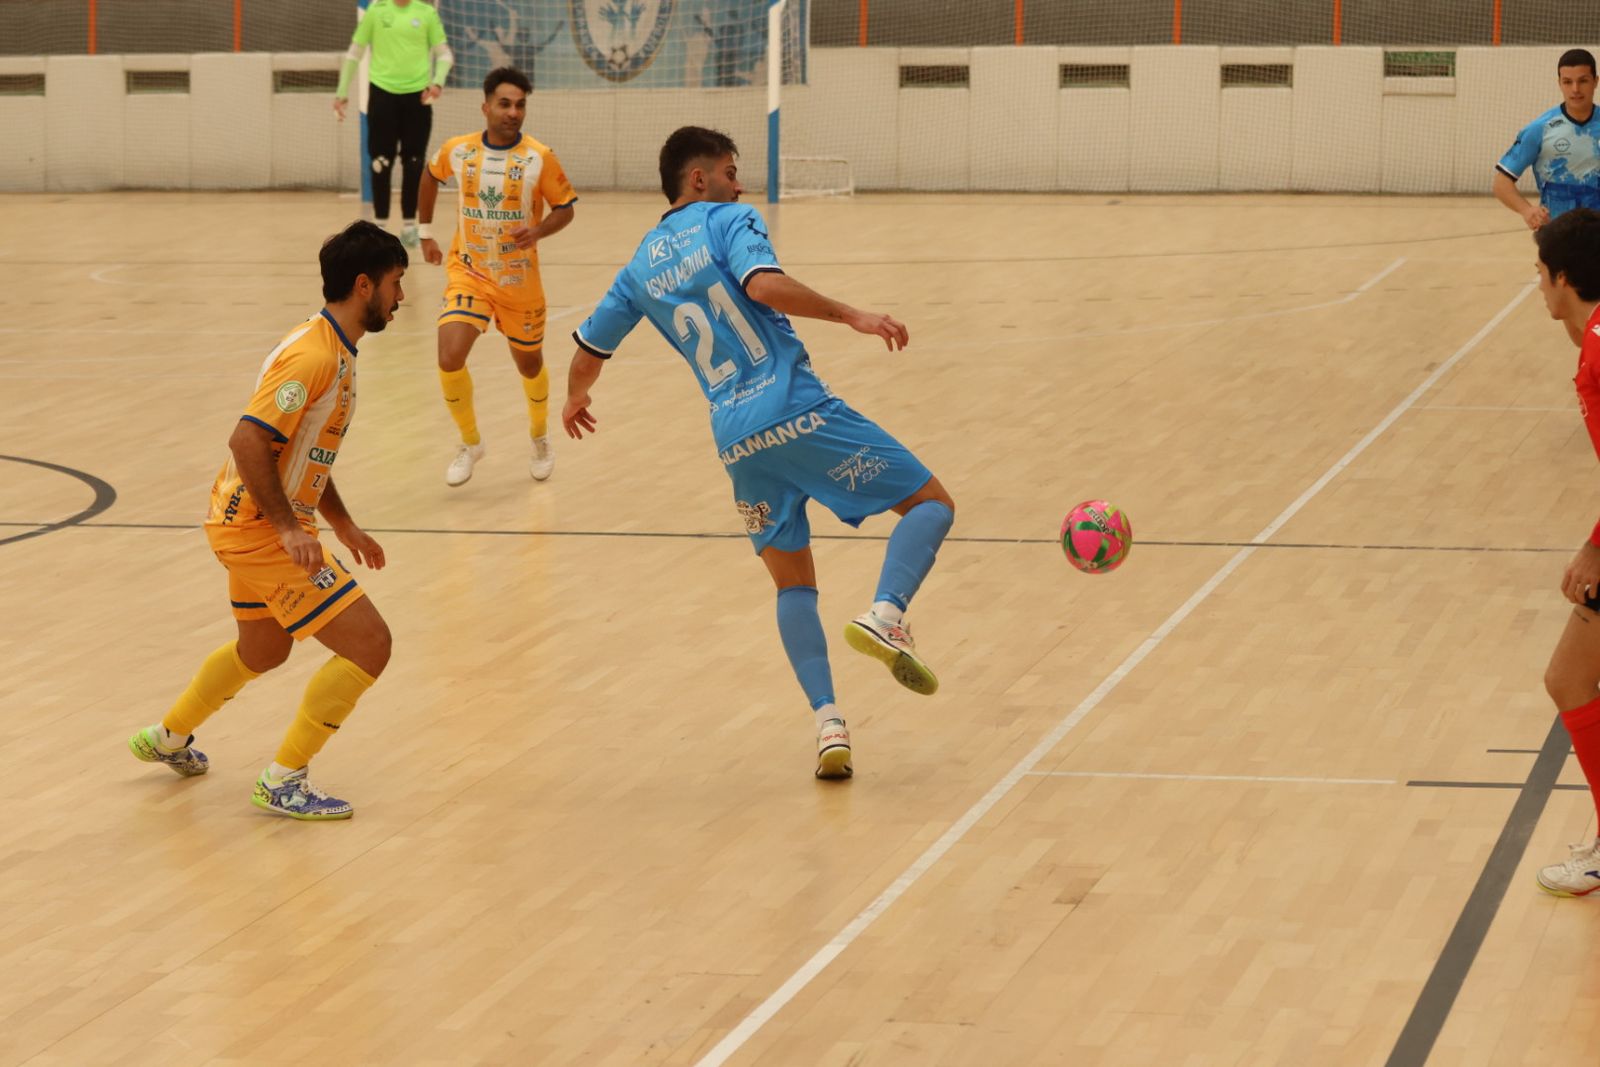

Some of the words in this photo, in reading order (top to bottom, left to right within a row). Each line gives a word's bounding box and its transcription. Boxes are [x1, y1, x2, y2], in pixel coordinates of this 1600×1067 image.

[486, 210, 524, 220] RURAL
[645, 269, 676, 299] ISMA
[456, 294, 474, 308] 11
[673, 281, 768, 392] 21
[721, 411, 827, 466] LAMANCA
